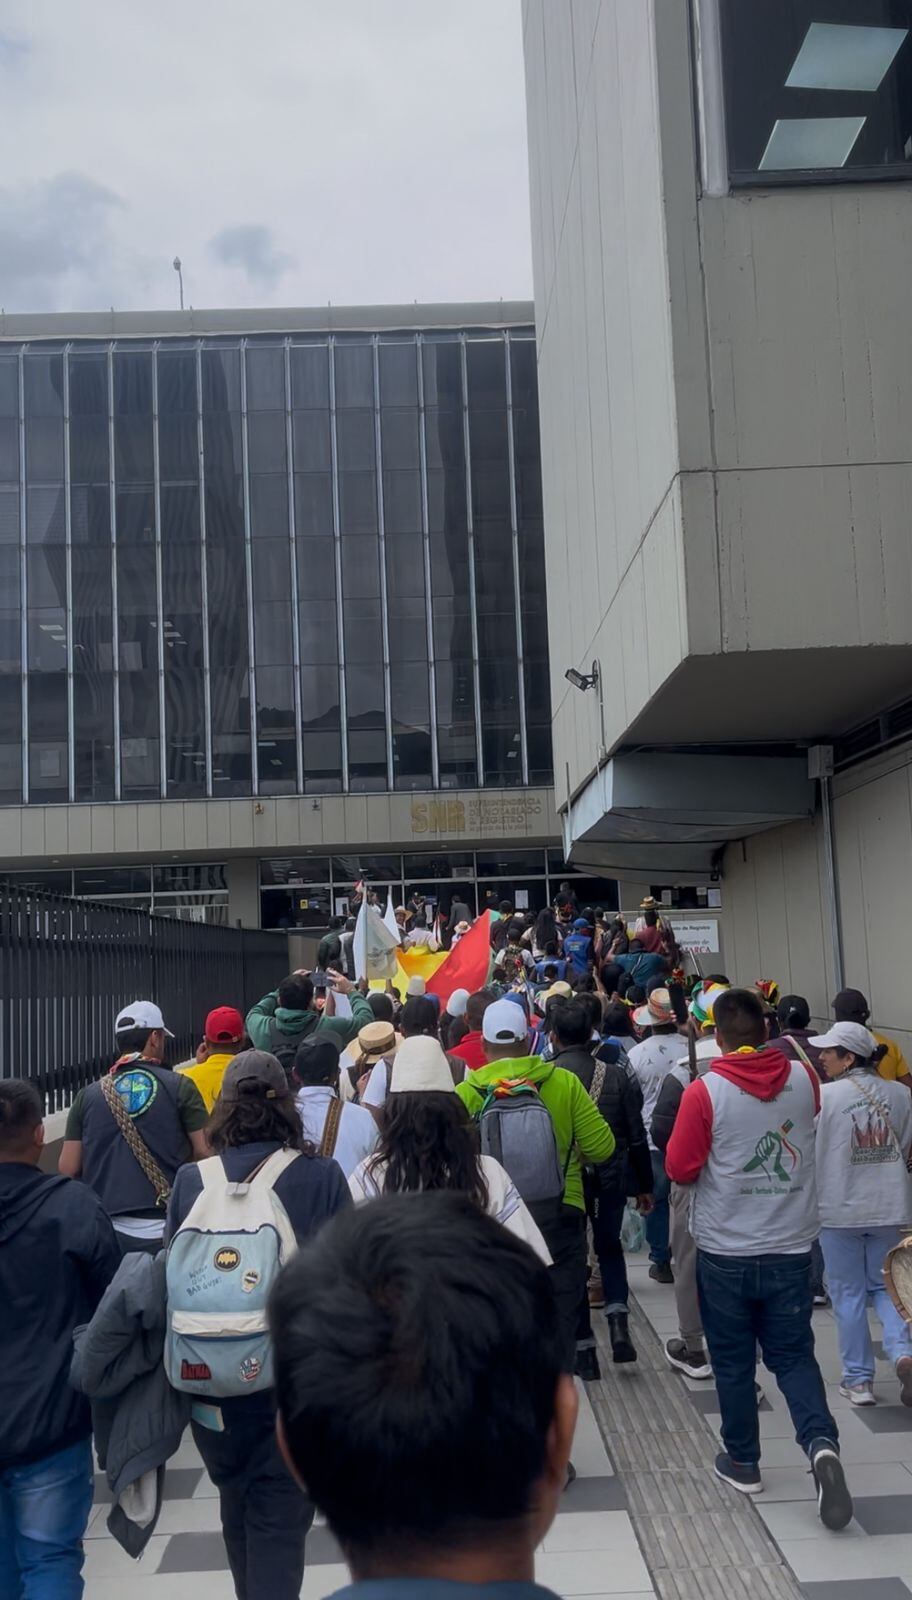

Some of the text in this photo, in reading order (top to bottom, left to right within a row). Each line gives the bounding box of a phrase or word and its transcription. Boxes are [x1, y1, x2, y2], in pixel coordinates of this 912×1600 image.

[411, 799, 466, 833] SNR
[483, 806, 542, 816] NOTARIADO
[480, 815, 524, 825] REGISTRO
